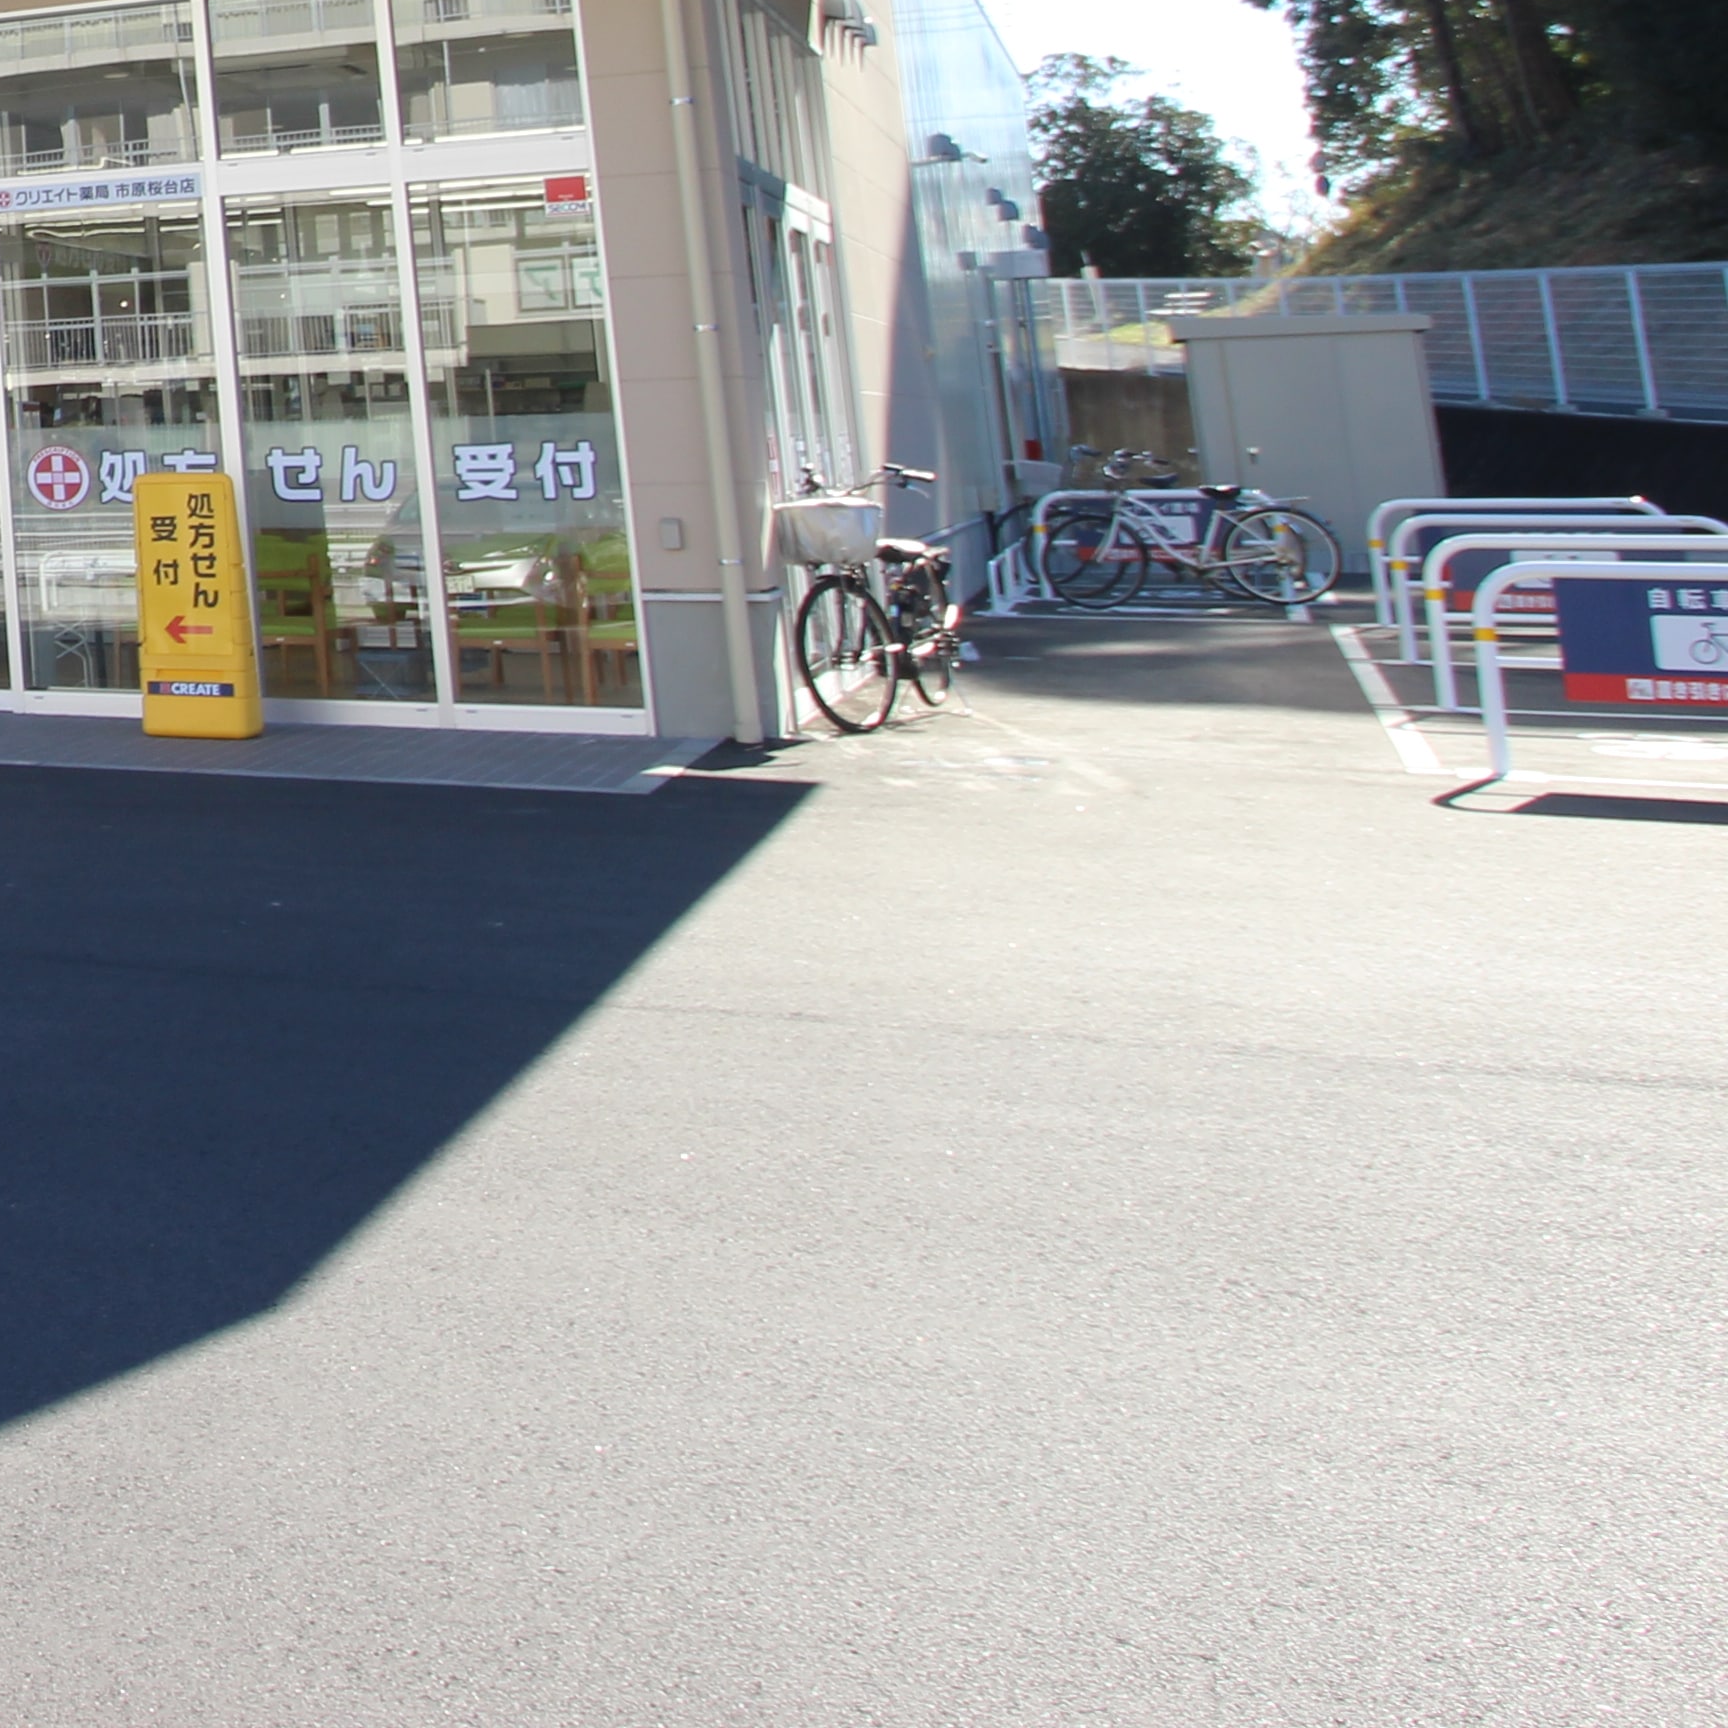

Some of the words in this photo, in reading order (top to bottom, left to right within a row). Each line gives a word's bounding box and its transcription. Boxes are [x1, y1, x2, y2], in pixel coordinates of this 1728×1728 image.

[15, 185, 109, 206] クリエイト薬局
[115, 178, 194, 198] 市原桜台店
[150, 516, 179, 586] 受付
[187, 493, 219, 608] 処方せん
[171, 683, 220, 697] CREATE
